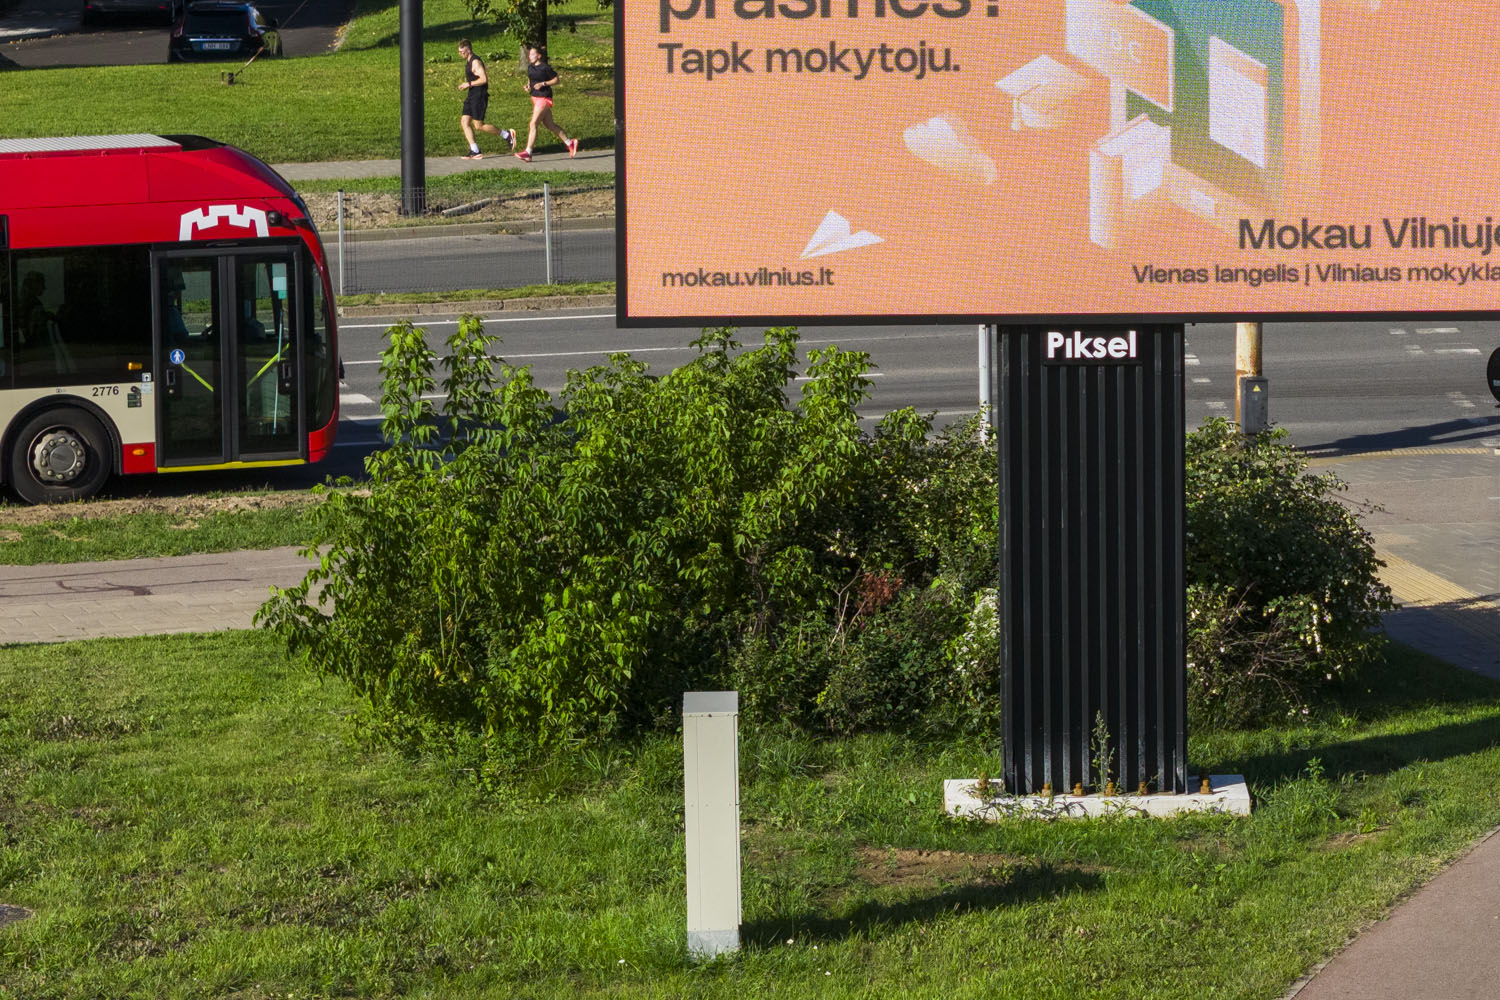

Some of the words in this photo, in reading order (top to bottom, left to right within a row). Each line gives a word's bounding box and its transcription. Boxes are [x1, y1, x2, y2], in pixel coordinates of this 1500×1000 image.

[658, 41, 755, 81] Tapk
[765, 40, 961, 81] mokytoju.
[1238, 217, 1372, 250] Mokau
[662, 267, 835, 288] mokau.vilnius.lt
[1132, 265, 1209, 284] Vienas
[1215, 264, 1300, 287] langelis
[1315, 264, 1402, 283] Vilniaus
[1047, 330, 1136, 359] Piksel
[92, 385, 119, 397] 2776
